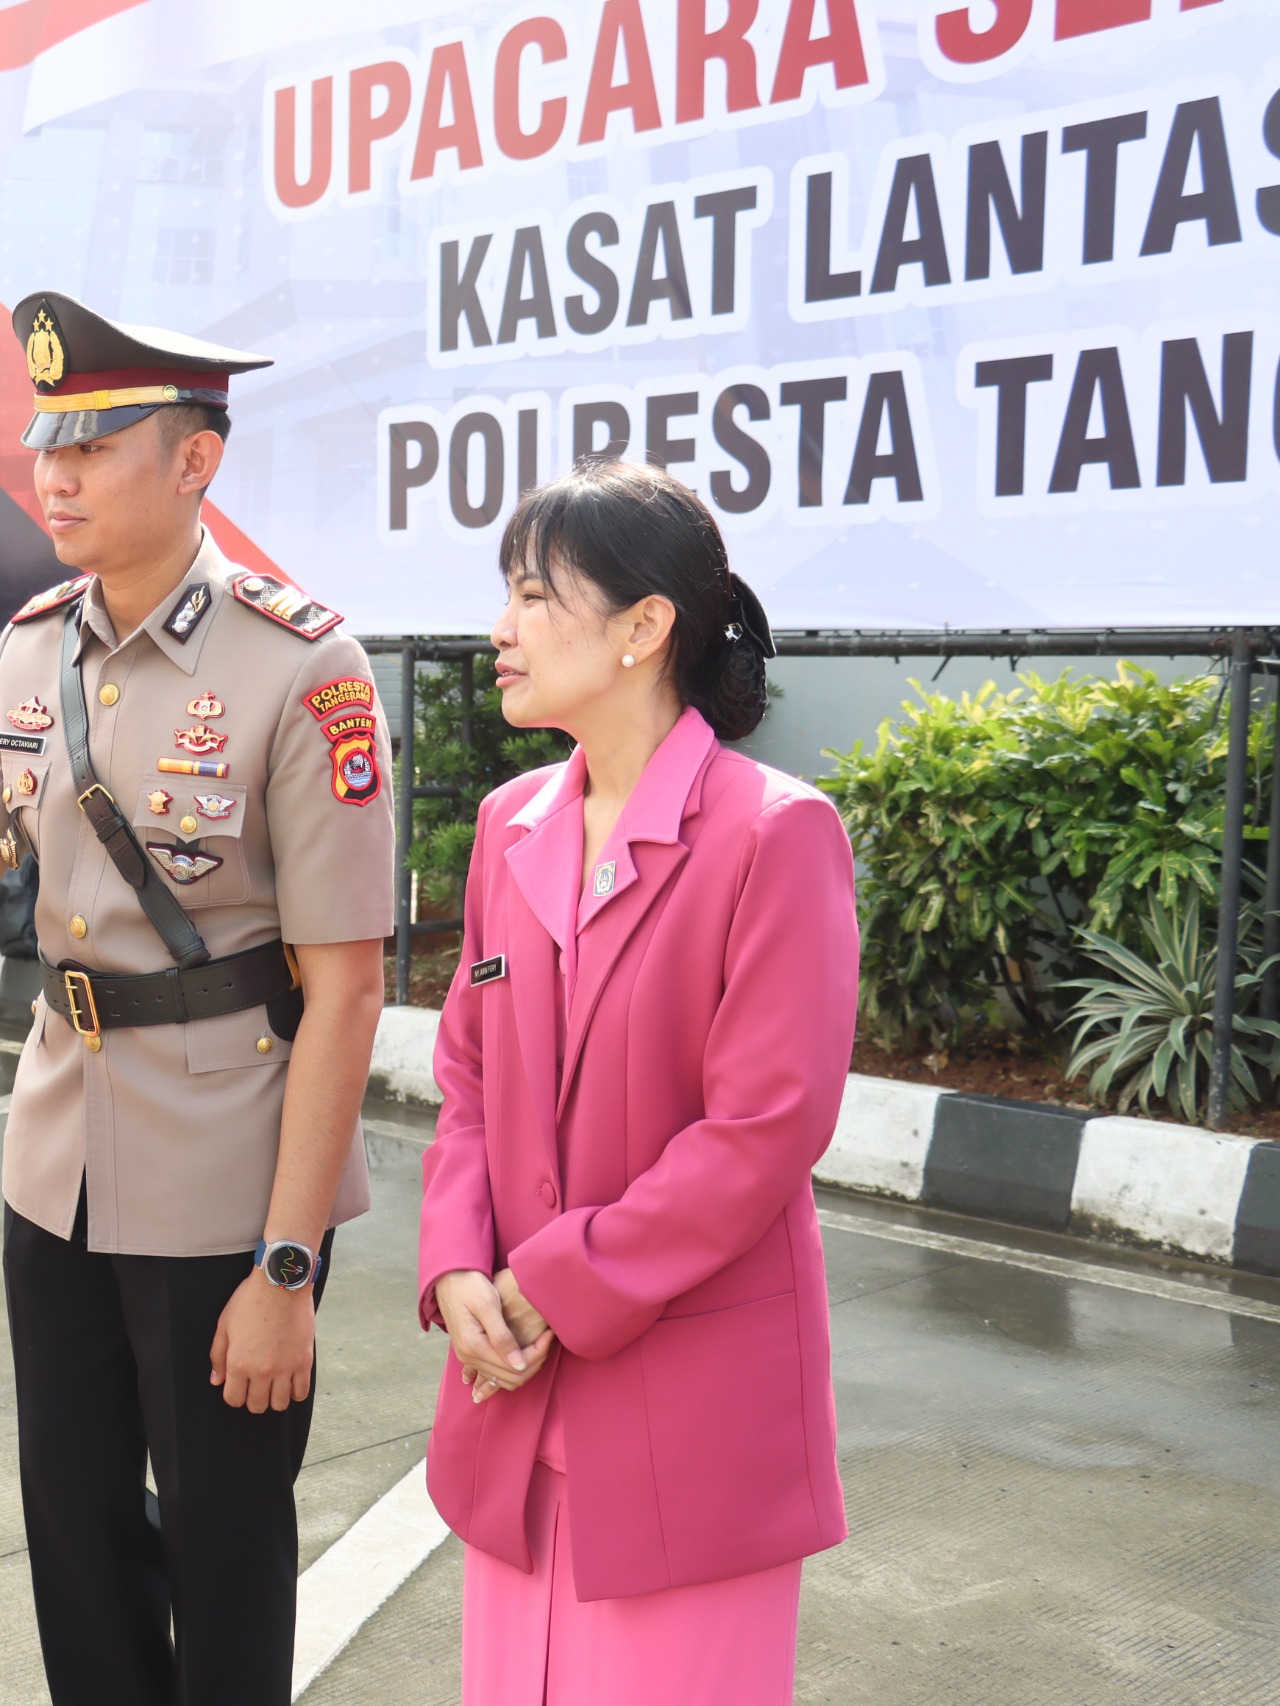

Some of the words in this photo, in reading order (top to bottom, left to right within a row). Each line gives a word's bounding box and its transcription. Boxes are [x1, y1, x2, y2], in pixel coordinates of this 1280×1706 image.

[273, 0, 868, 209] UPACARA
[438, 186, 757, 352] KASAT
[974, 330, 1280, 497] TAN
[311, 681, 371, 708] POLRESTA
[319, 691, 370, 712] TANGERANG
[329, 717, 373, 735] BANTEN
